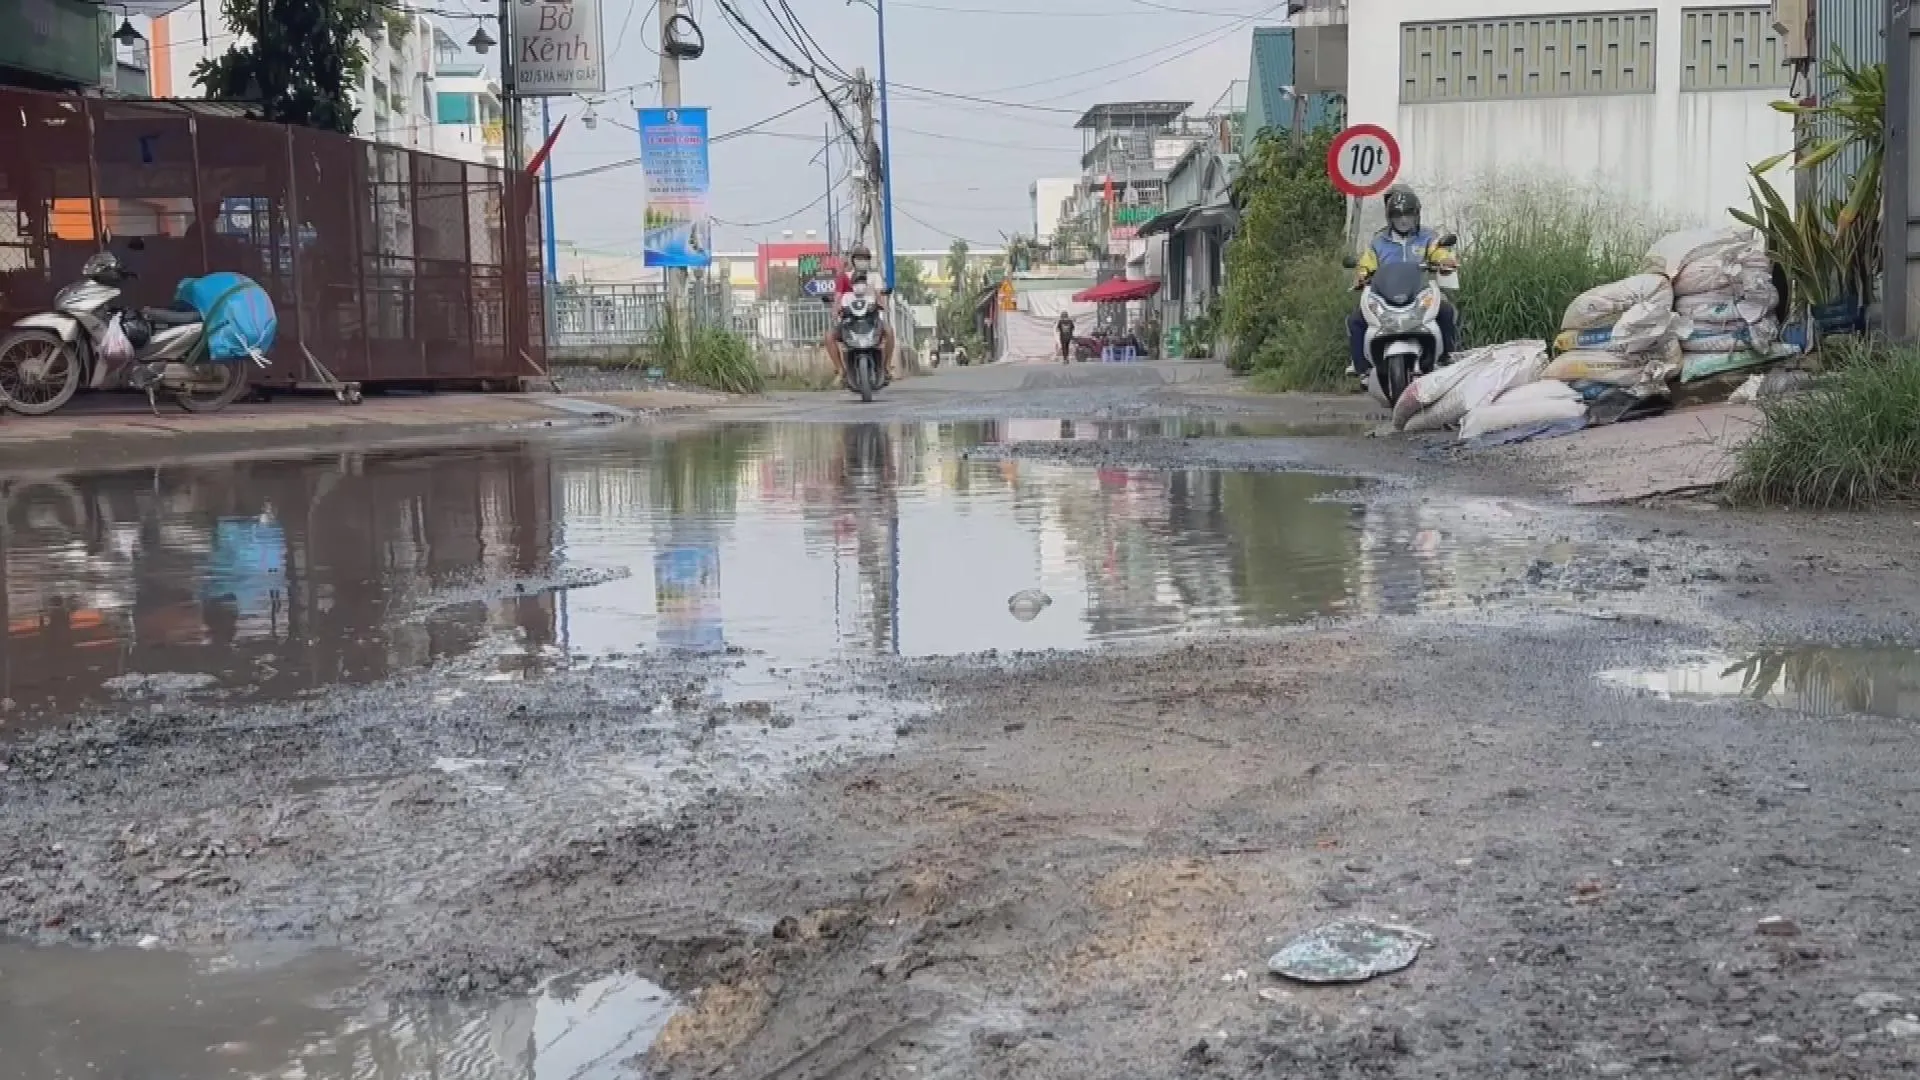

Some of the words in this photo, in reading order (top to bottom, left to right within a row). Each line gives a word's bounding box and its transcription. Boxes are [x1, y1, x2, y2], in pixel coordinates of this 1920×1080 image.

[538, 5, 574, 31] Bờ
[520, 34, 591, 62] Kênh
[556, 69, 574, 82] HUY
